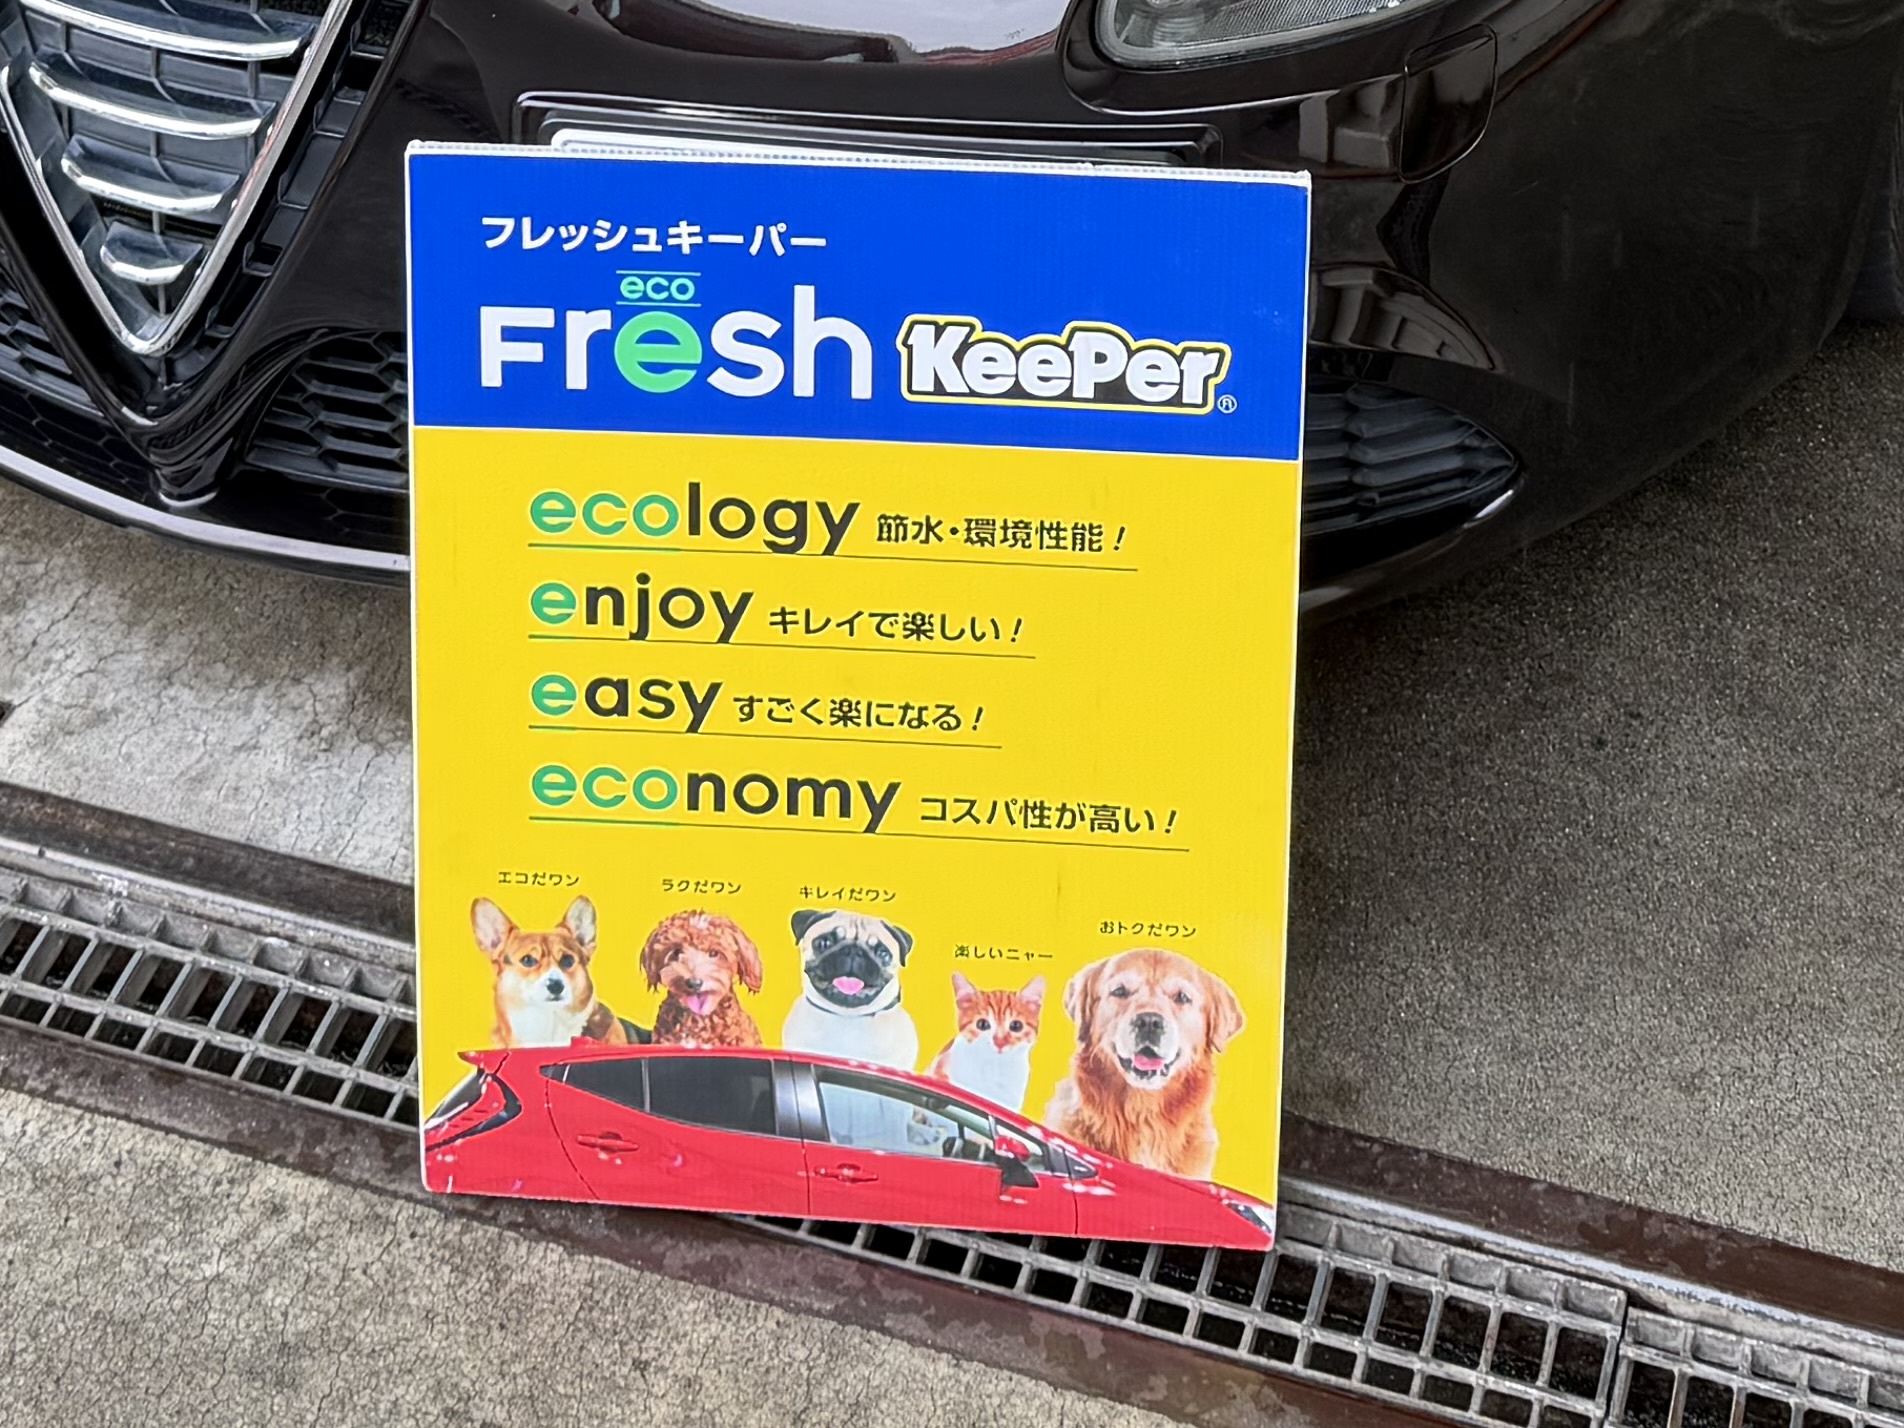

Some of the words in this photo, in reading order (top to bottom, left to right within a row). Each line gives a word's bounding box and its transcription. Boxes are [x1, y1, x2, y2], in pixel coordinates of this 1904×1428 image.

[481, 216, 827, 257] フレッシュキーパー
[620, 276, 696, 302] eco
[480, 284, 873, 401] Fresh
[902, 318, 1226, 411] KeePer
[530, 481, 861, 556] ecology
[530, 572, 755, 645] enjoy
[769, 605, 1023, 644] キレイで楽しい！
[531, 674, 724, 734] easy
[733, 695, 985, 732] すごく楽になる！
[531, 764, 902, 834] economy
[920, 796, 1178, 834] コスパ性が高い！
[498, 871, 580, 887] エコだワン
[661, 878, 742, 894] ラクだワン
[799, 884, 897, 903] キレイだワン
[1099, 920, 1197, 938] おトクだワン
[954, 945, 1054, 962] 楽しいニャー
